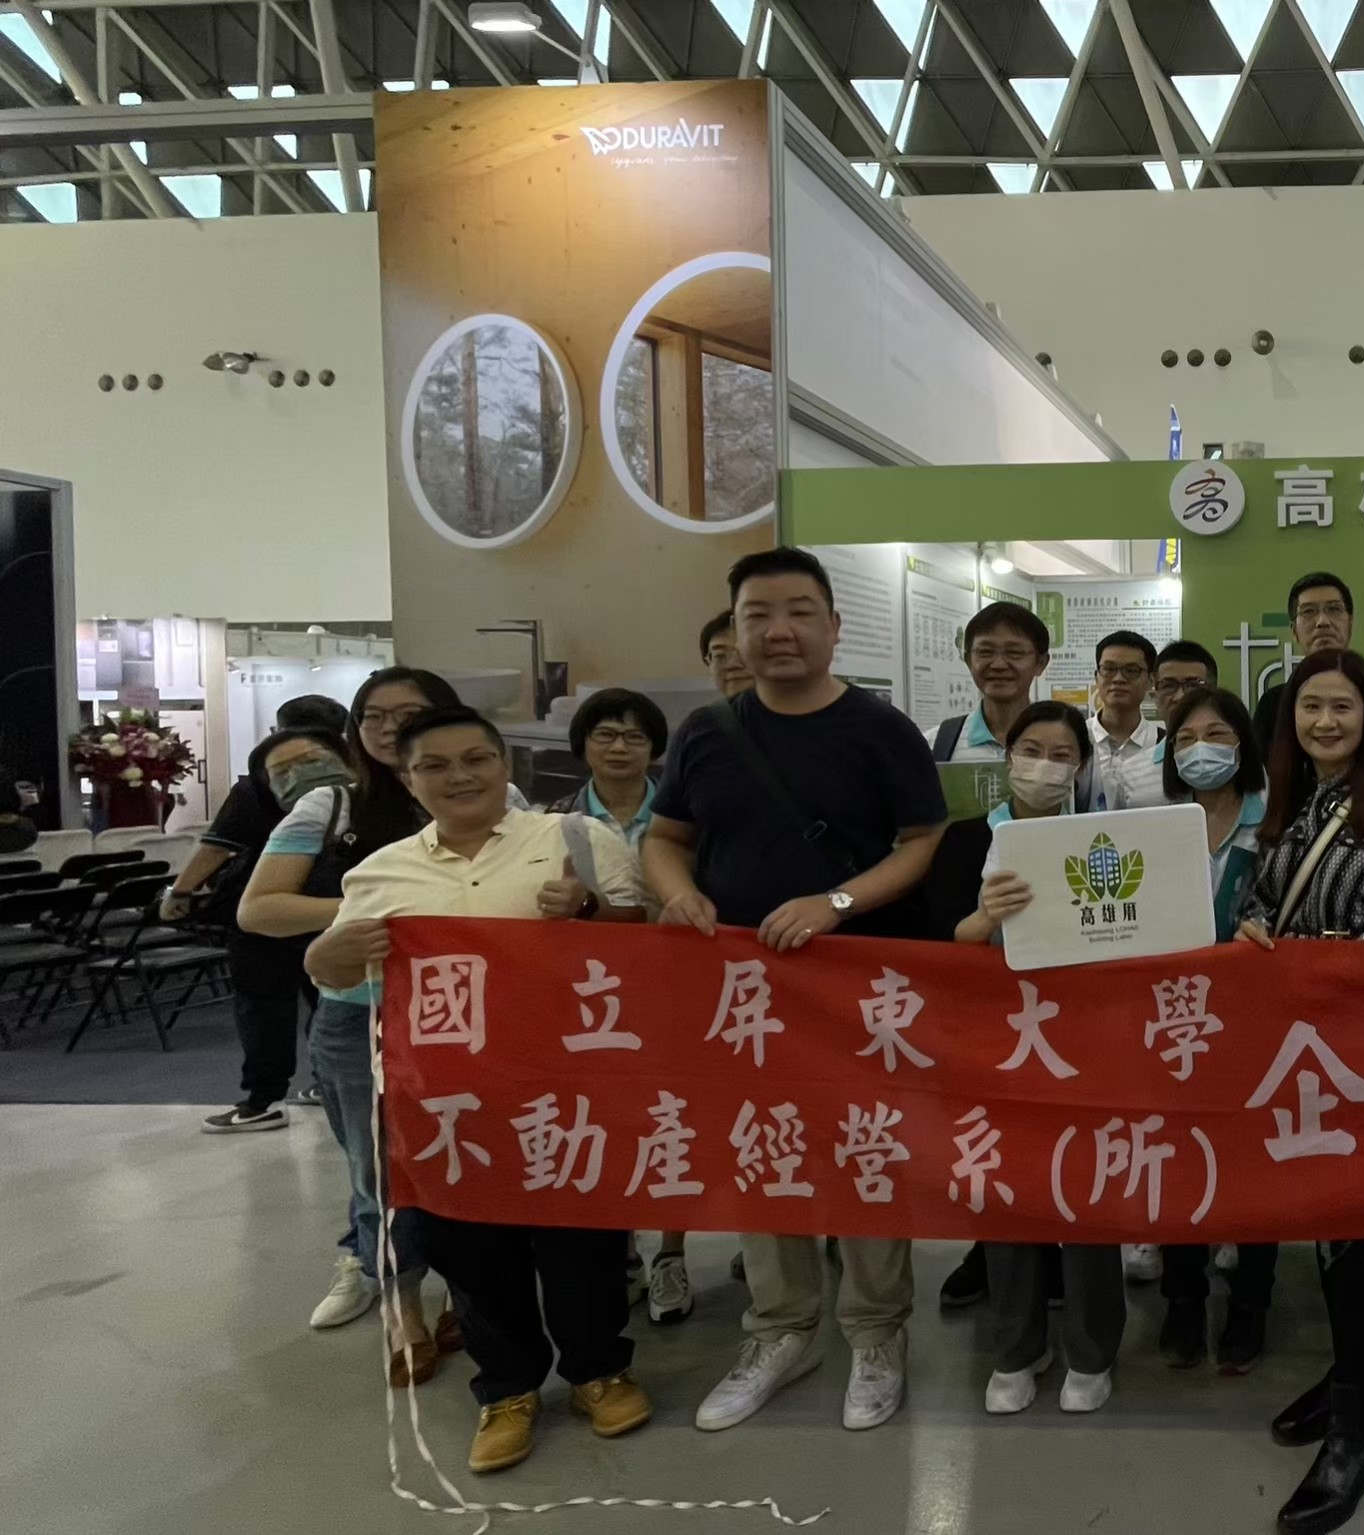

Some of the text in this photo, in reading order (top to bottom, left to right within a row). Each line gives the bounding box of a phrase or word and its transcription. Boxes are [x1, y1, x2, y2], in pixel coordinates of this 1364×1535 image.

[623, 117, 724, 150] DURAVIT
[409, 955, 1224, 1082] 國立屏東大學
[413, 1090, 1217, 1225] 不動產經營系(所)
